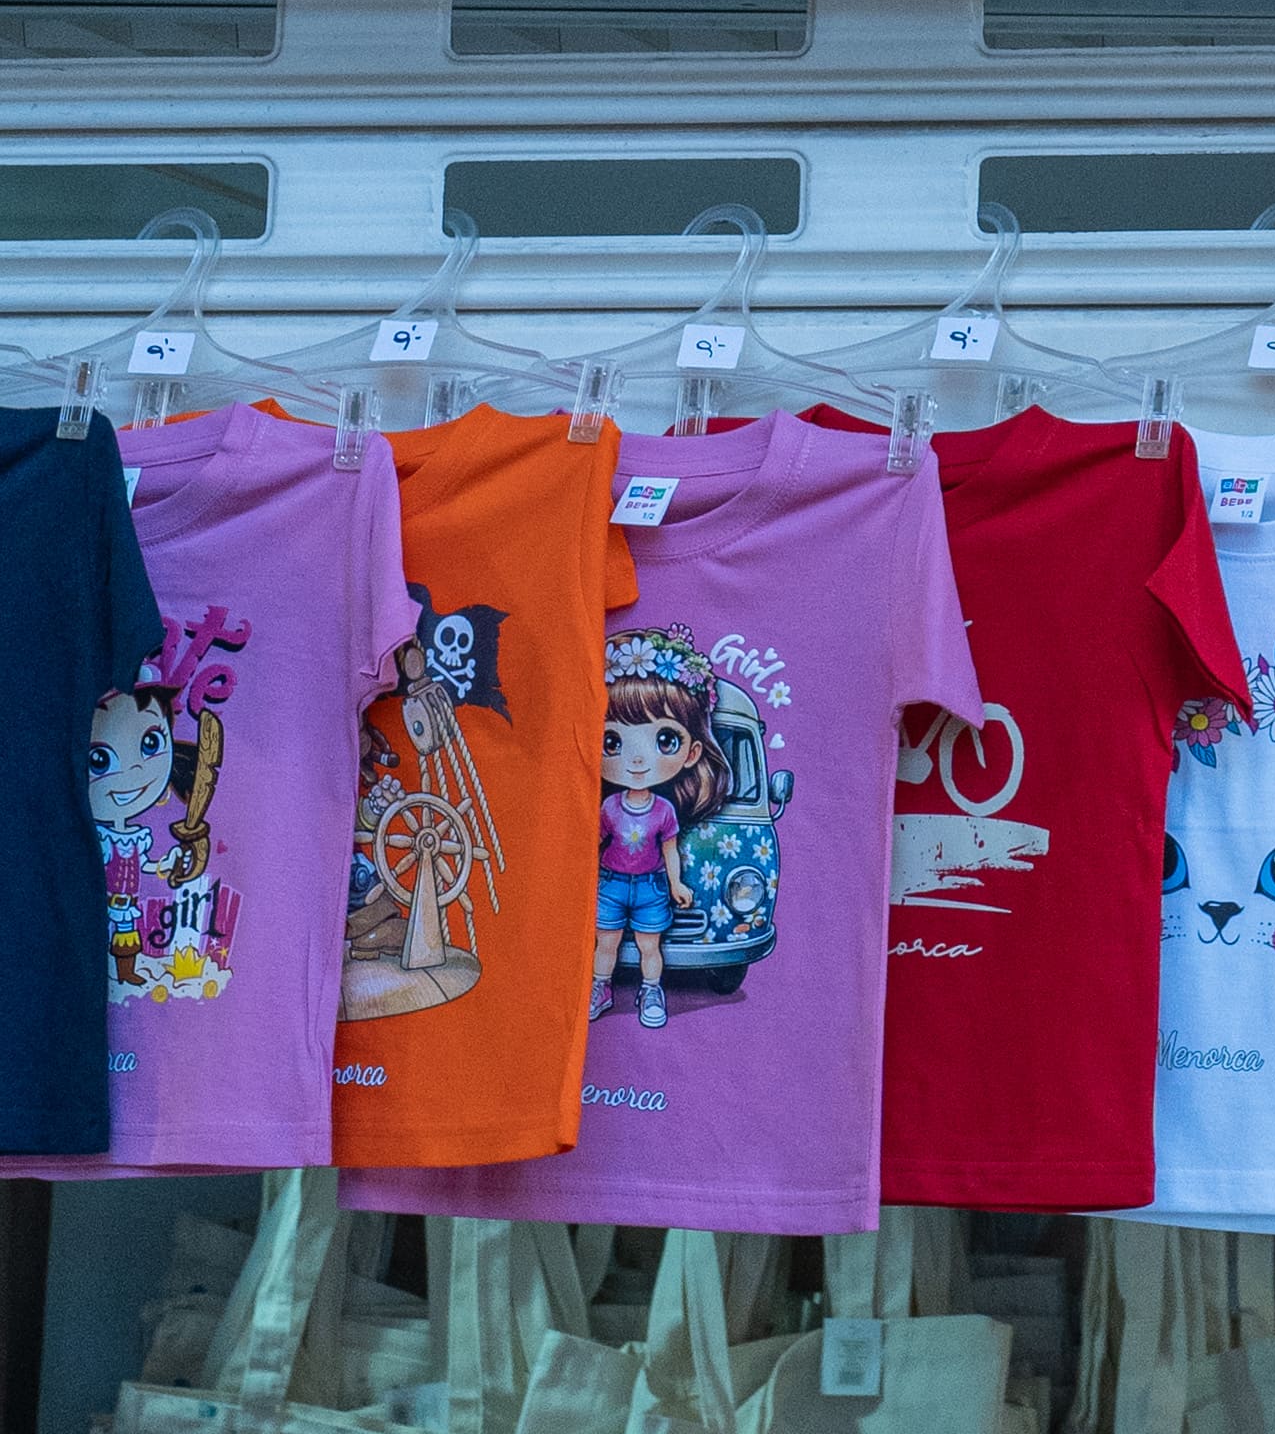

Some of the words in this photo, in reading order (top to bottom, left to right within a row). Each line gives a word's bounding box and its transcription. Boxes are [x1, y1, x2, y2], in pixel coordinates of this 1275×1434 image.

[1241, 510, 1254, 518] 1/2
[709, 633, 785, 694] Girl
[149, 877, 226, 949] girl
[1157, 1029, 1265, 1073] Menorca
